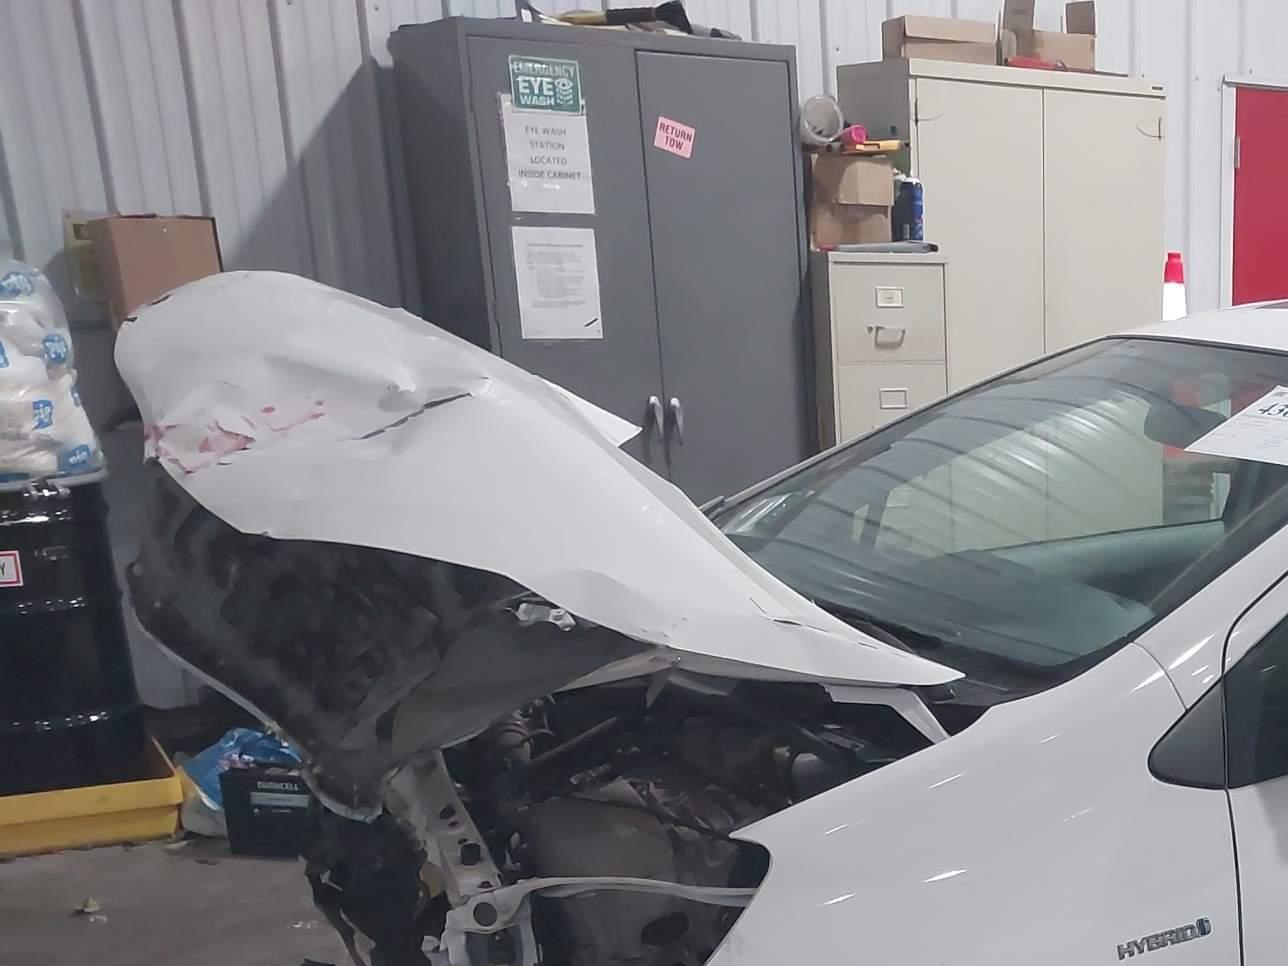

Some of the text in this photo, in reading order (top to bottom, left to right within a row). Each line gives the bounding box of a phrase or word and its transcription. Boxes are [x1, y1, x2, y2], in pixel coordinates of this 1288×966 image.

[517, 75, 554, 96] EYE
[520, 95, 555, 105] WASH
[524, 125, 567, 136] EYE WASH
[660, 122, 692, 142] RETURN
[529, 140, 565, 151] STATION
[665, 135, 684, 150] TOW
[530, 155, 568, 166] LOCATED
[546, 170, 581, 181] CABINET
[1117, 923, 1197, 961] HYBRID
